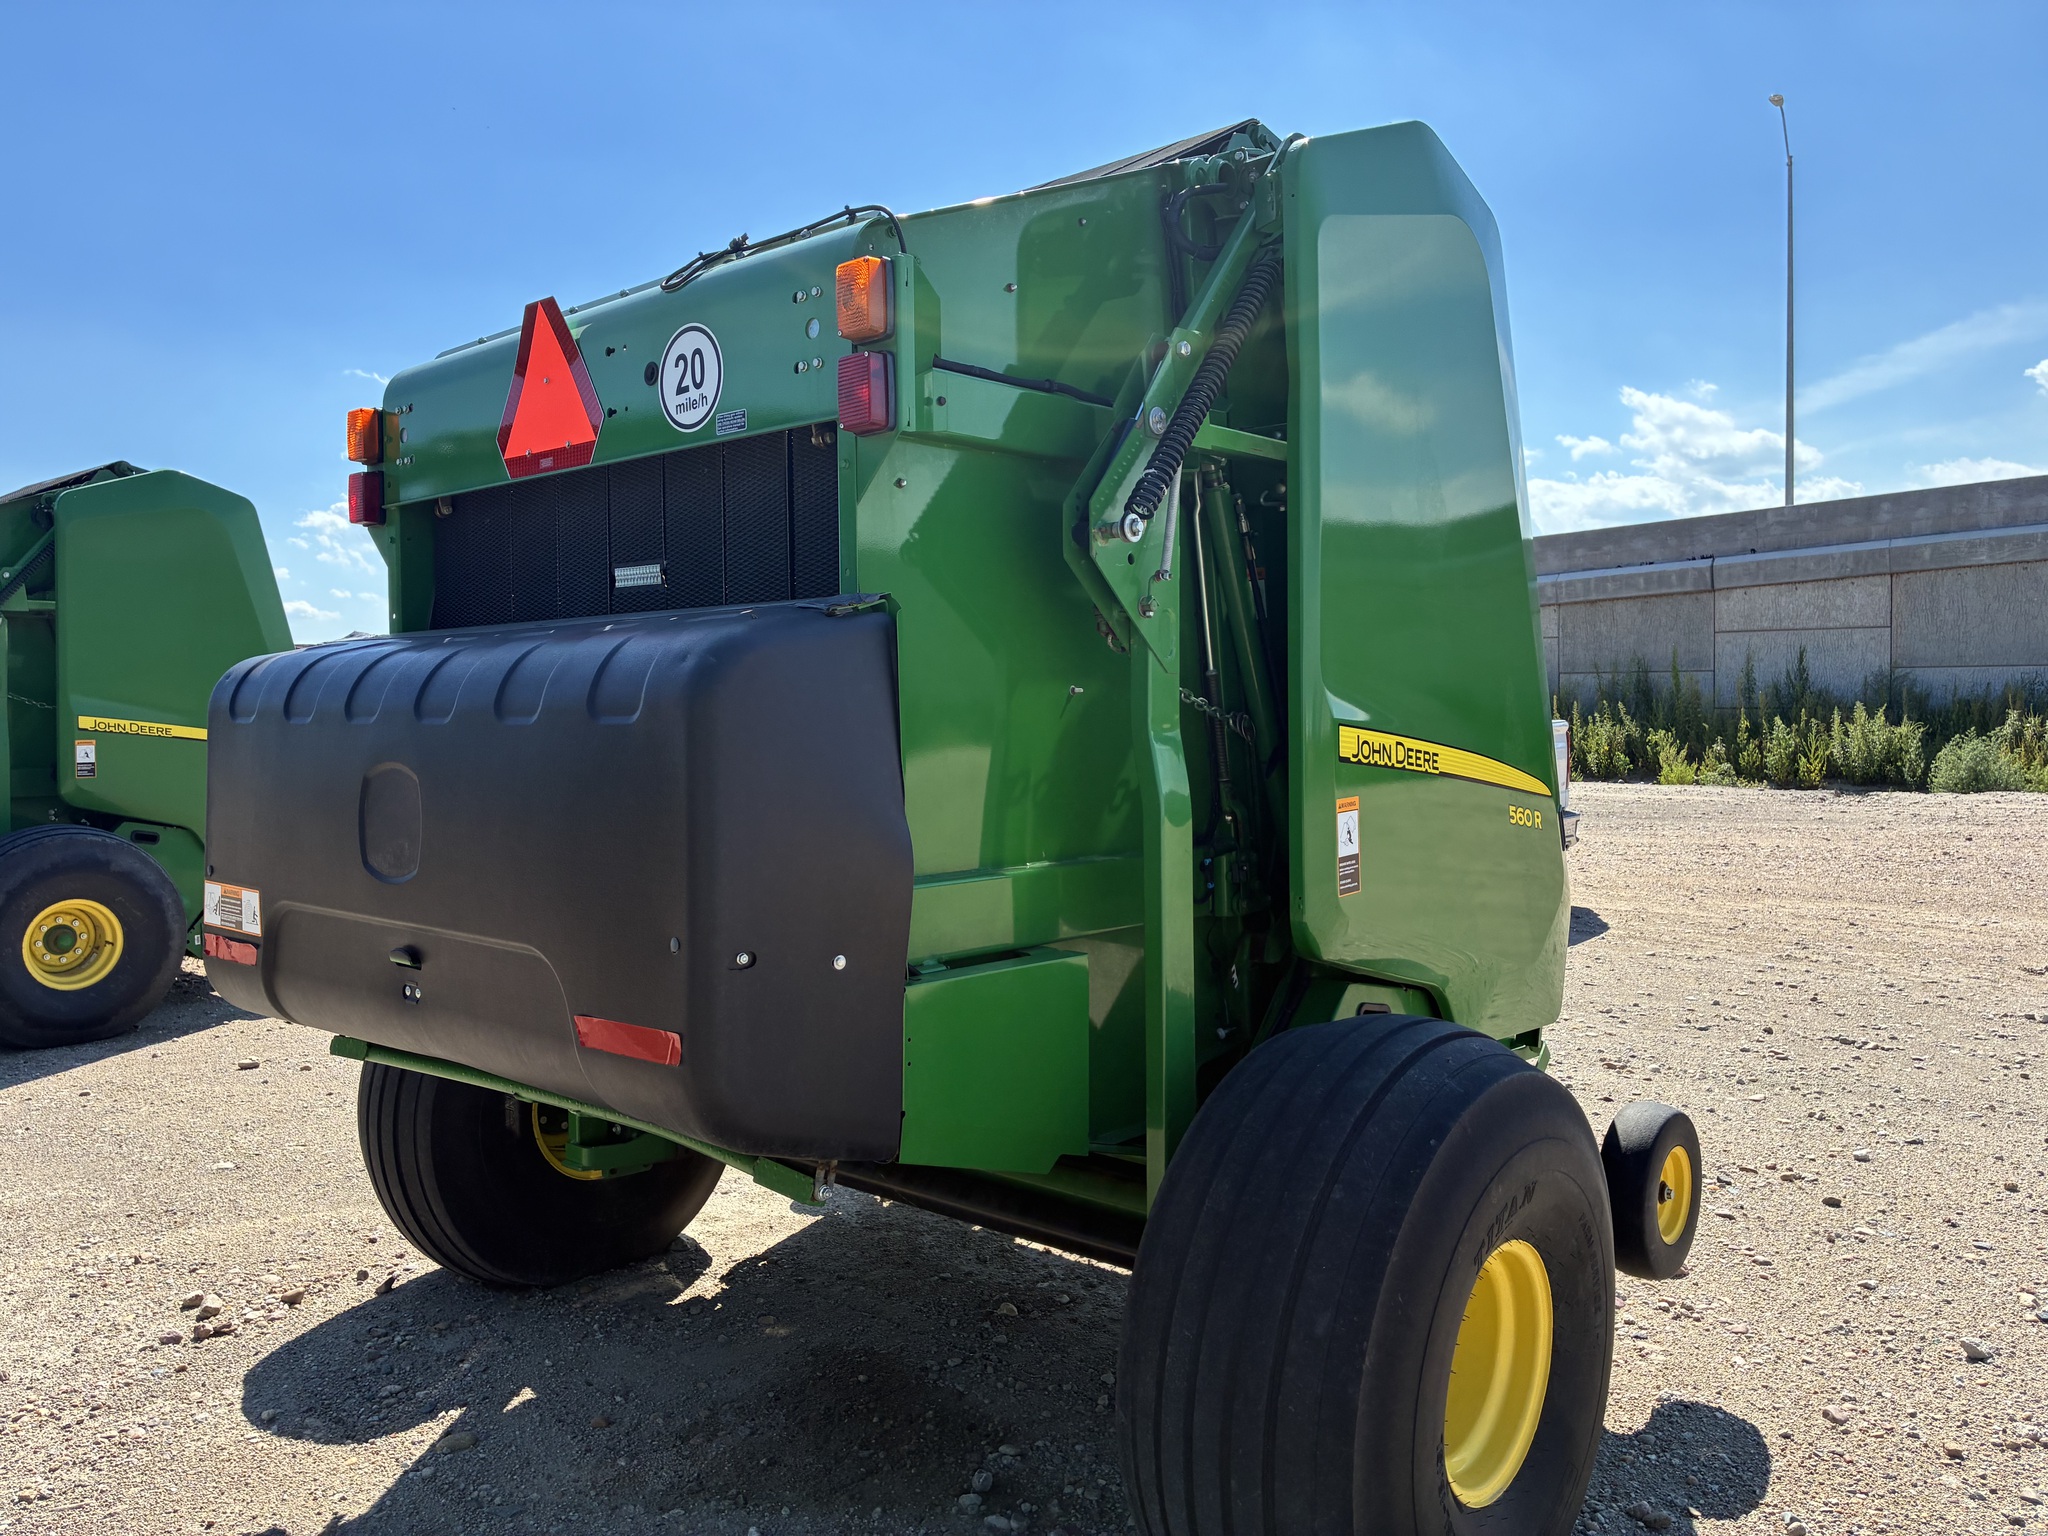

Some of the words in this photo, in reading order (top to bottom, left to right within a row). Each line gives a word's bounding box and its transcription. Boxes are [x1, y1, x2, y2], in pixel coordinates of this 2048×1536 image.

[674, 347, 705, 396] 20
[675, 393, 708, 415] mile/h
[89, 719, 126, 733] JOHN
[129, 723, 173, 736] DEERE
[1351, 734, 1392, 764] JOHN
[1395, 740, 1440, 771] DEERE
[1508, 804, 1533, 828] 560
[1534, 809, 1543, 830] R
[1473, 1179, 1538, 1276] TITAN
